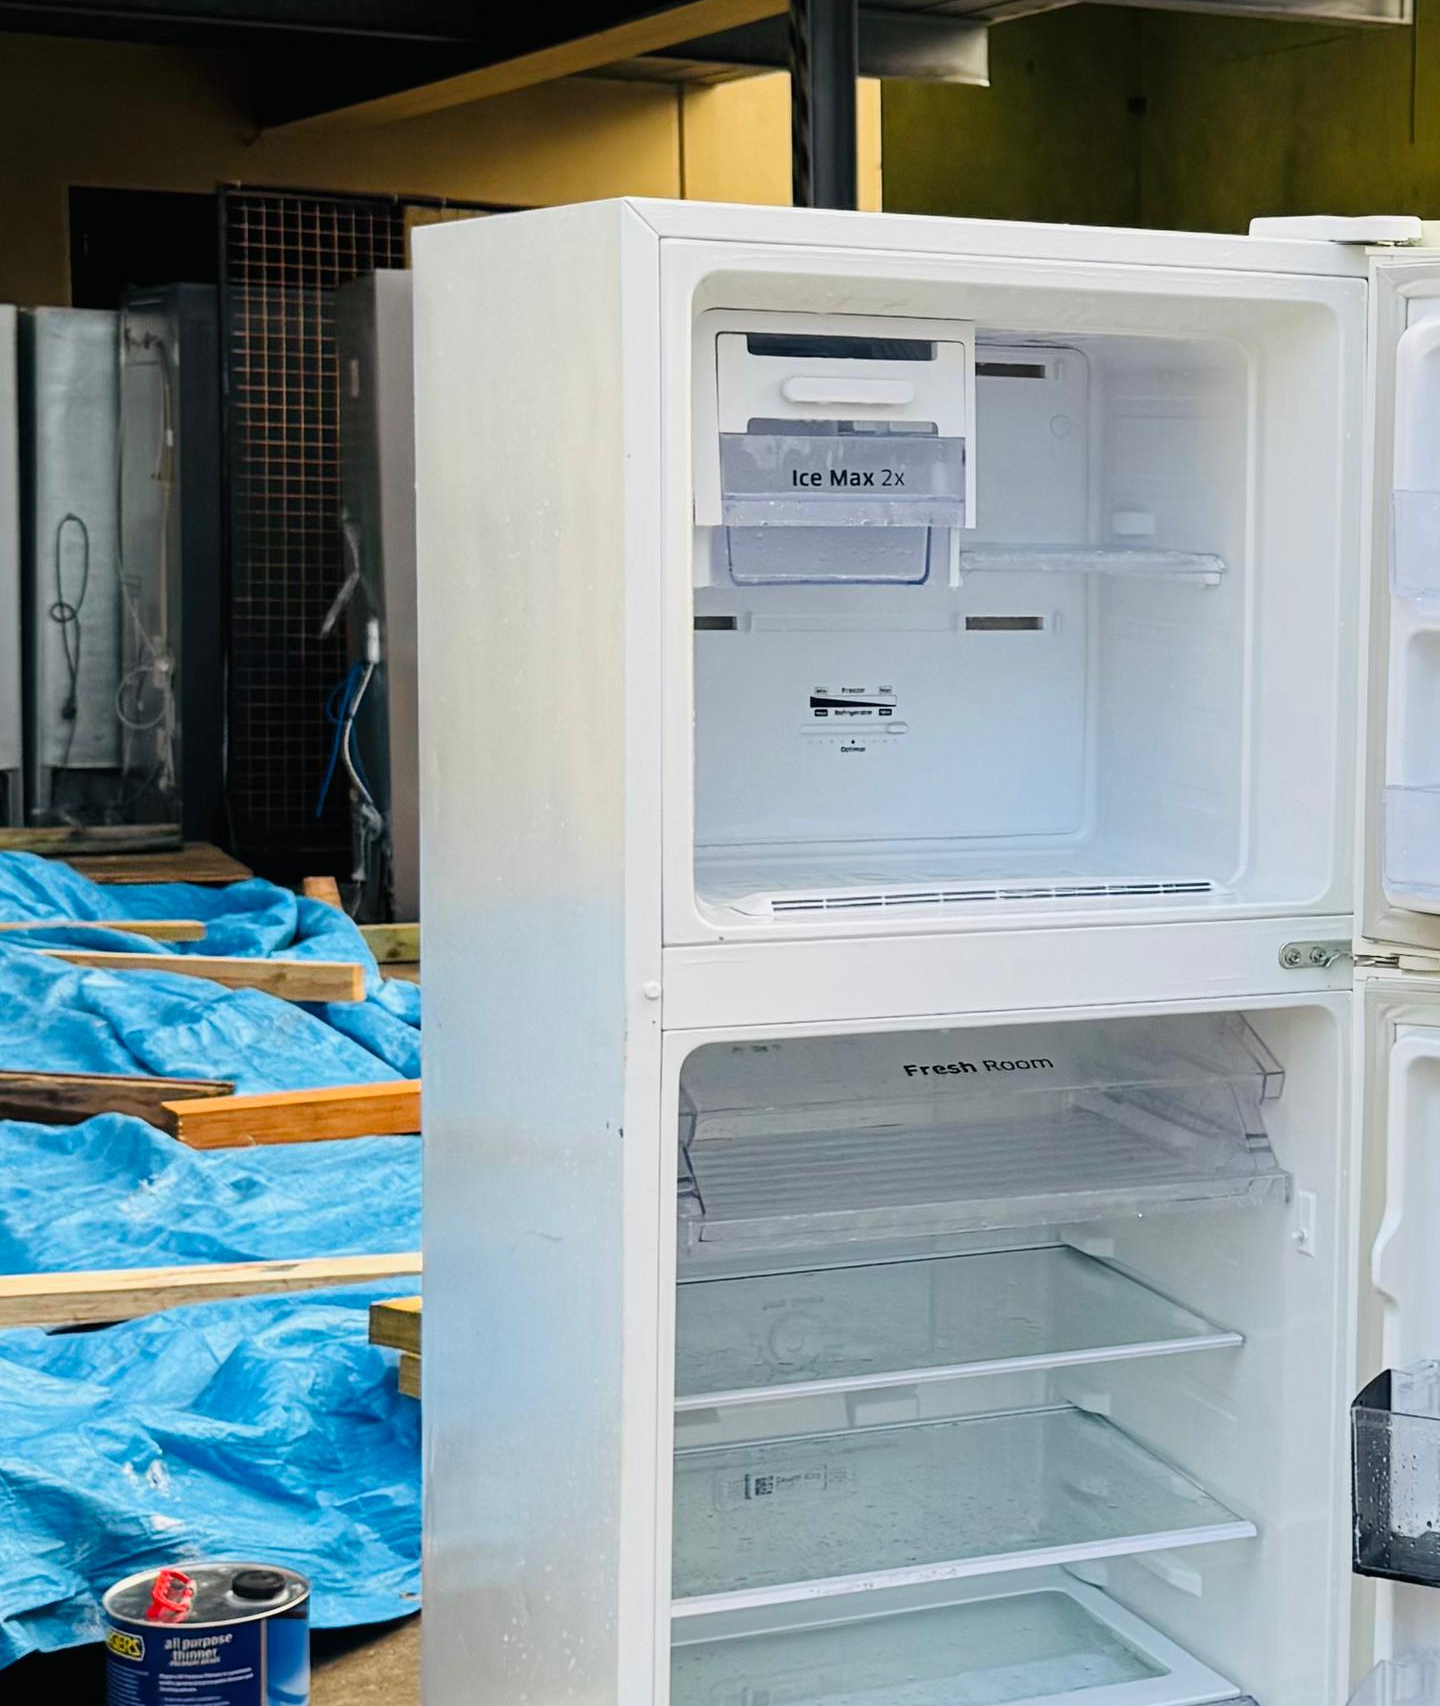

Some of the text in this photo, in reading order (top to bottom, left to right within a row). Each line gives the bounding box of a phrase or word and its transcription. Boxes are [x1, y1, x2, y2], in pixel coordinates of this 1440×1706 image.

[792, 469, 904, 487] Ice Max 2x
[903, 1058, 1054, 1077] Fresh Room
[164, 1633, 233, 1650] all purpose
[172, 1648, 218, 1662] thinner
